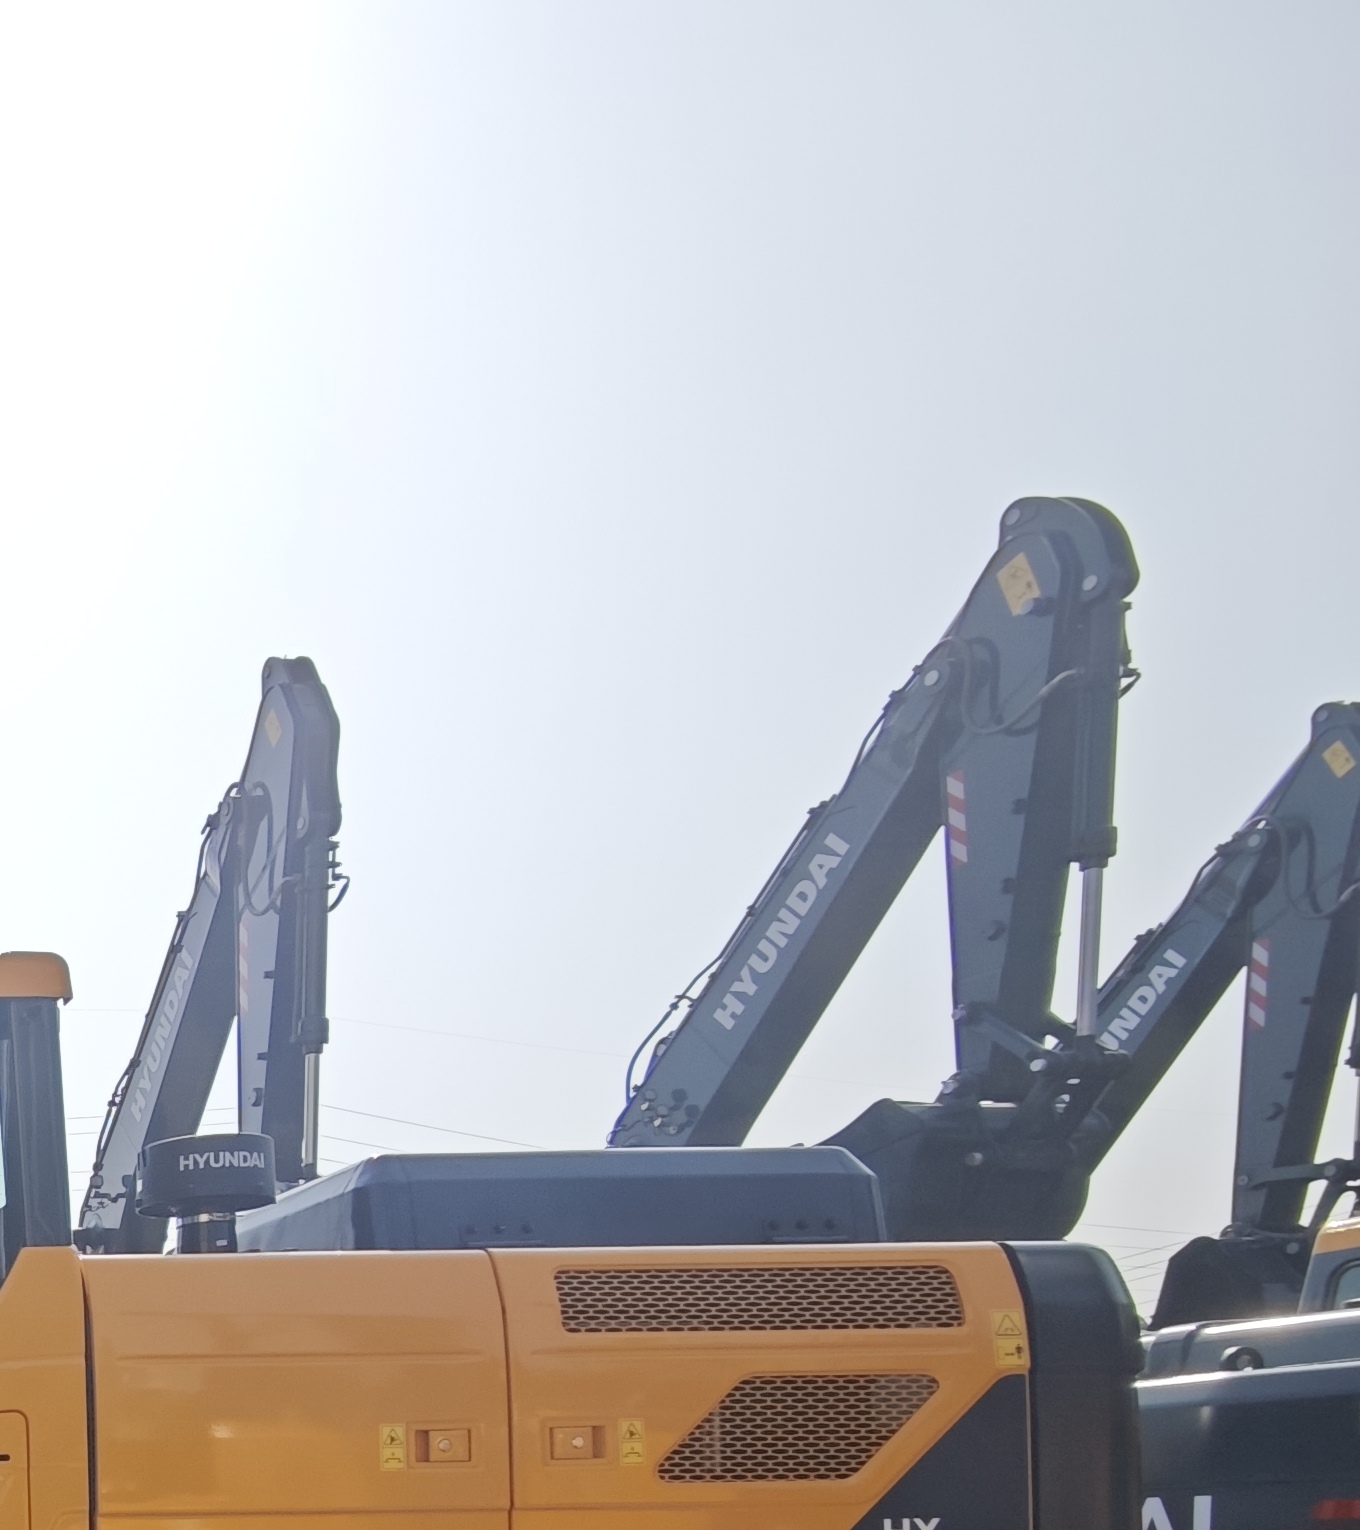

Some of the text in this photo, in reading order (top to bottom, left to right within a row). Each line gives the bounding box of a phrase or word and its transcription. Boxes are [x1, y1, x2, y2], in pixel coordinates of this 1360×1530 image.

[713, 833, 850, 1030] HYUNDAI
[1095, 948, 1187, 1051] UNDAI
[131, 948, 193, 1122] HYUNDAI
[179, 1151, 265, 1171] HYUNDAI
